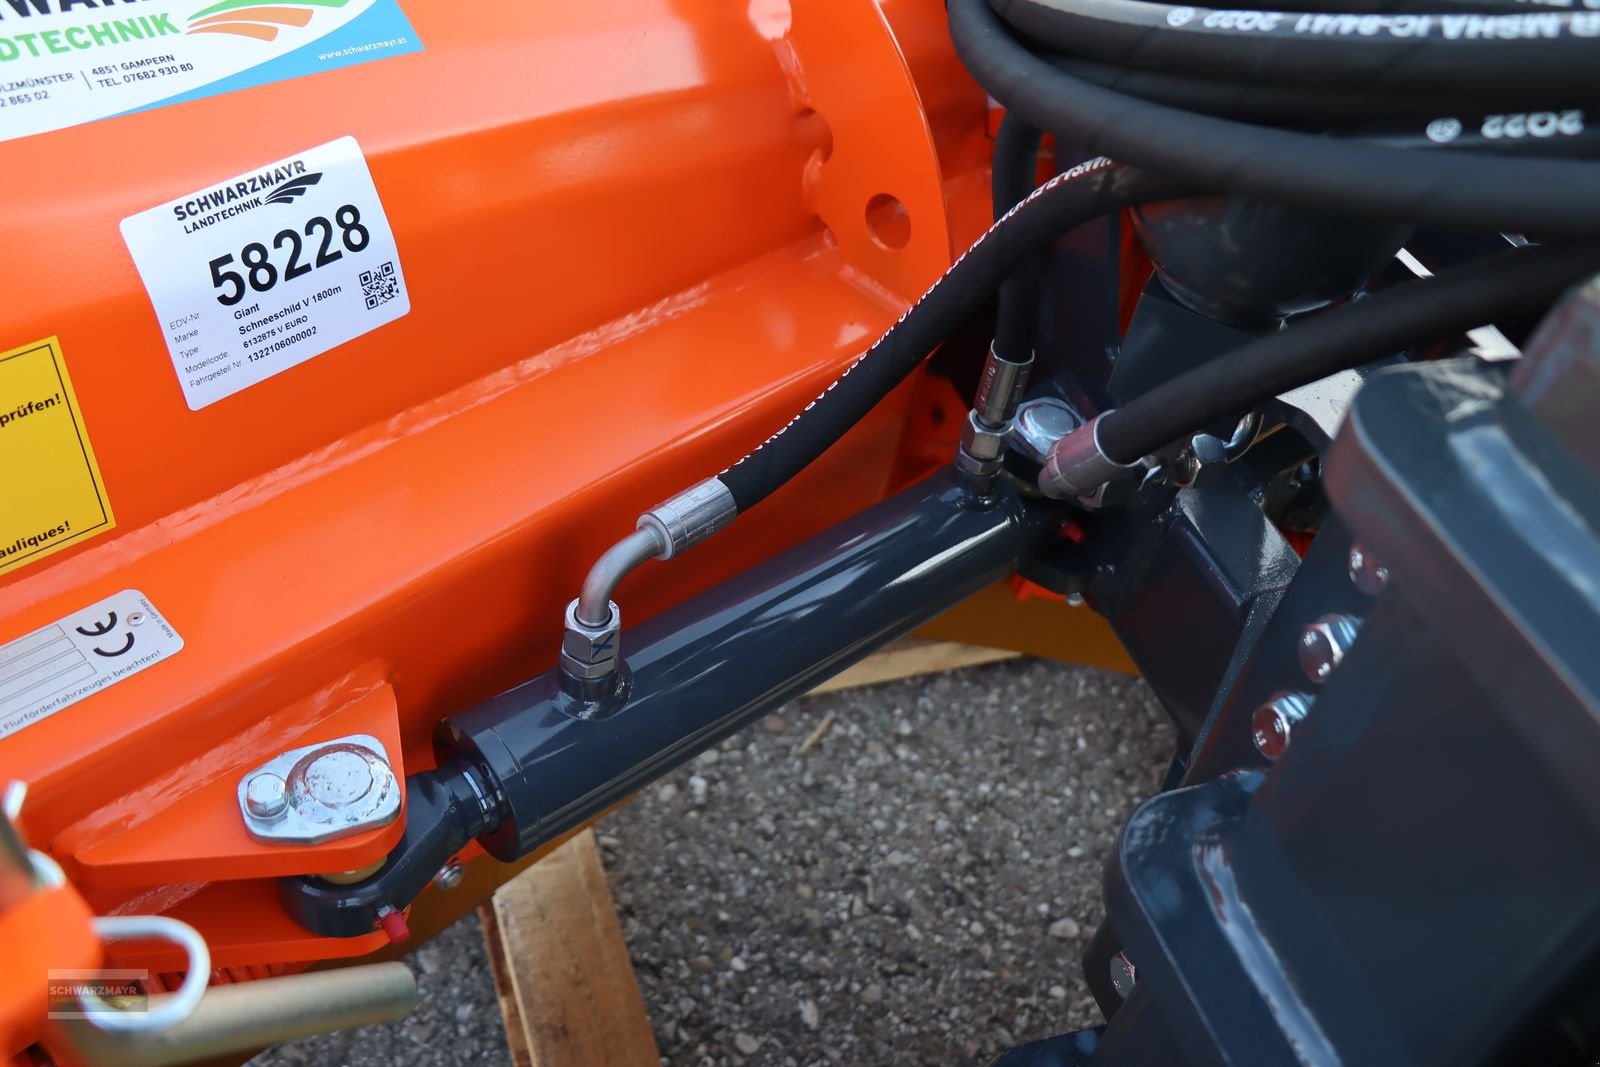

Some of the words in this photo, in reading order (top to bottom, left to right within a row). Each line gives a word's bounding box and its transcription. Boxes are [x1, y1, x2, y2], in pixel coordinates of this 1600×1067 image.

[1203, 10, 1283, 31] 2022
[317, 36, 408, 62] www.schwarzmayr.at
[91, 63, 120, 77] 4851
[121, 54, 175, 71] GAMPERN
[97, 77, 121, 89] TEL.
[123, 69, 158, 84] 07682
[158, 65, 179, 77] 930
[180, 62, 194, 73] 80
[0, 72, 75, 94] LZMÜNSTER
[34, 90, 50, 101] 02
[1480, 110, 1585, 139] 2022
[173, 159, 307, 222] SCHWARZMAYR
[183, 196, 263, 235] LANDTECHNIK
[208, 204, 370, 307] 58228
[233, 302, 261, 321] Giant
[238, 301, 302, 336] Schneeschild
[301, 298, 311, 309] V
[311, 285, 343, 304] 1800m
[174, 329, 199, 345] Marke
[243, 329, 277, 350] 6132875
[277, 325, 286, 335] V
[285, 315, 309, 331] EURO
[248, 325, 318, 364] 1322106000002
[180, 346, 199, 360] Type
[184, 350, 229, 375] Modellcode
[189, 365, 233, 388] Fahrgestell
[232, 360, 242, 370] Nr
[0, 393, 61, 428] prüfen!
[113, 650, 162, 678] beachten!
